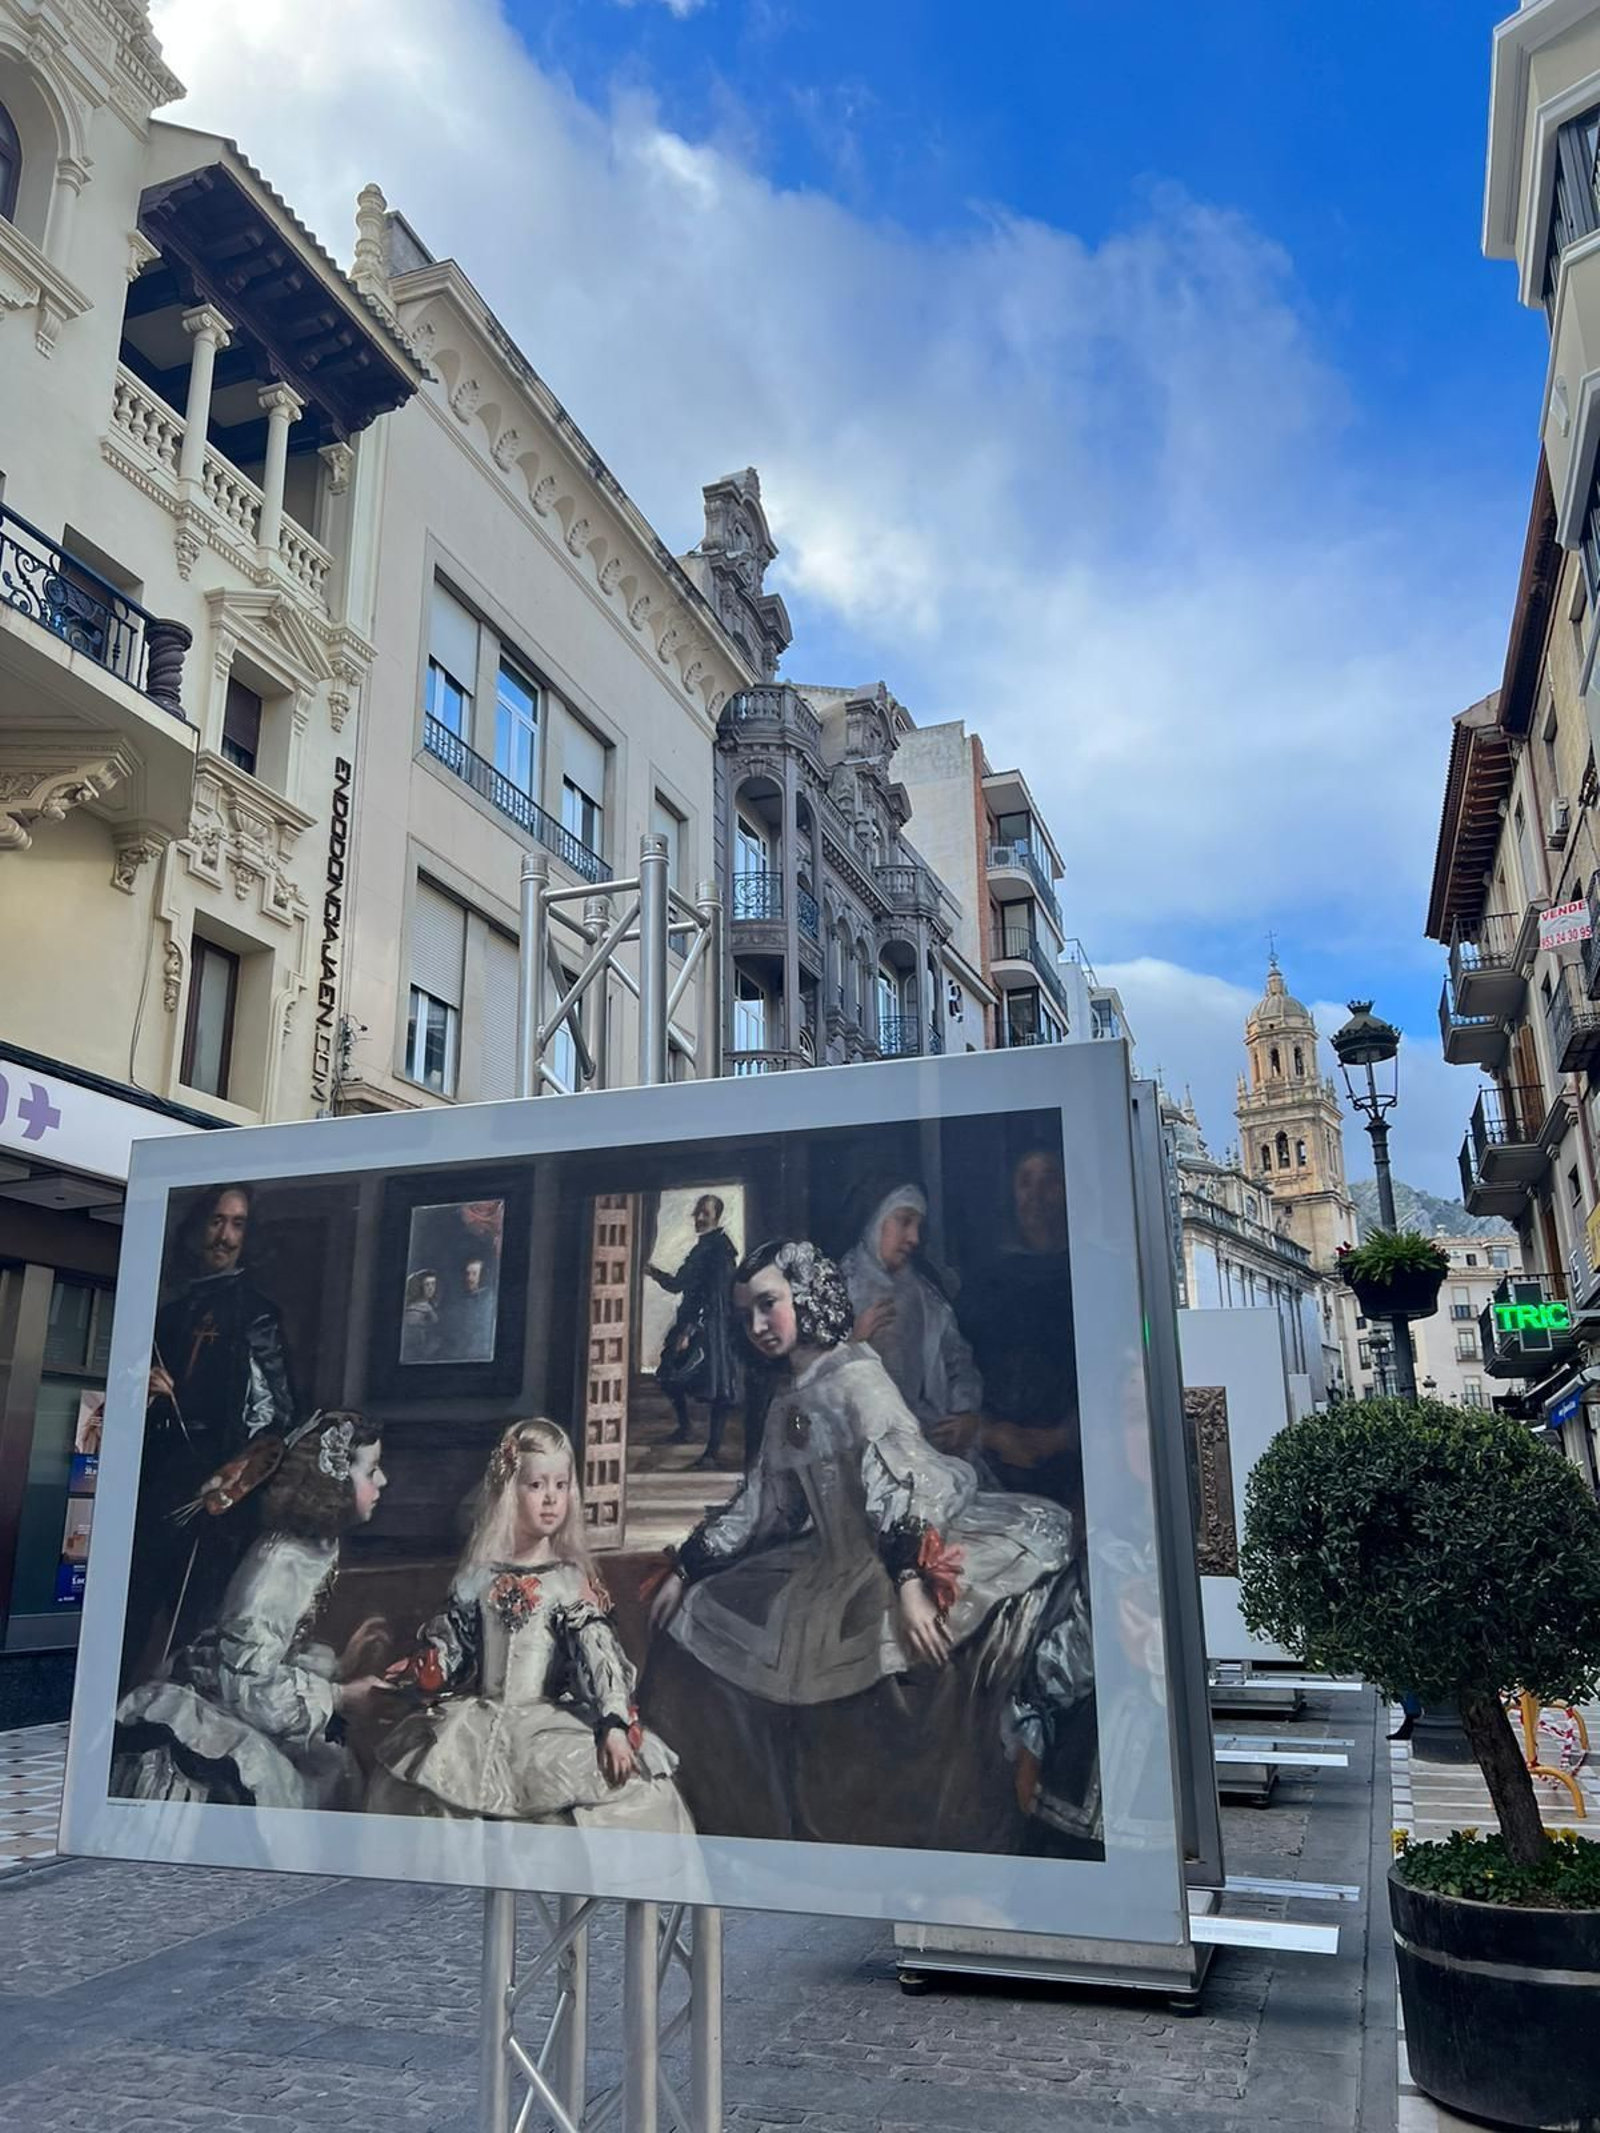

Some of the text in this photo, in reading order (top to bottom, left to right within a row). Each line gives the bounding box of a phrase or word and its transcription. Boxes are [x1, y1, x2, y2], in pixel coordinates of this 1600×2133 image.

[1541, 901, 1587, 921] VENDE
[310, 756, 352, 1102] ENDODONCIAJAEN.COM
[1494, 1303, 1570, 1333] TRIC
